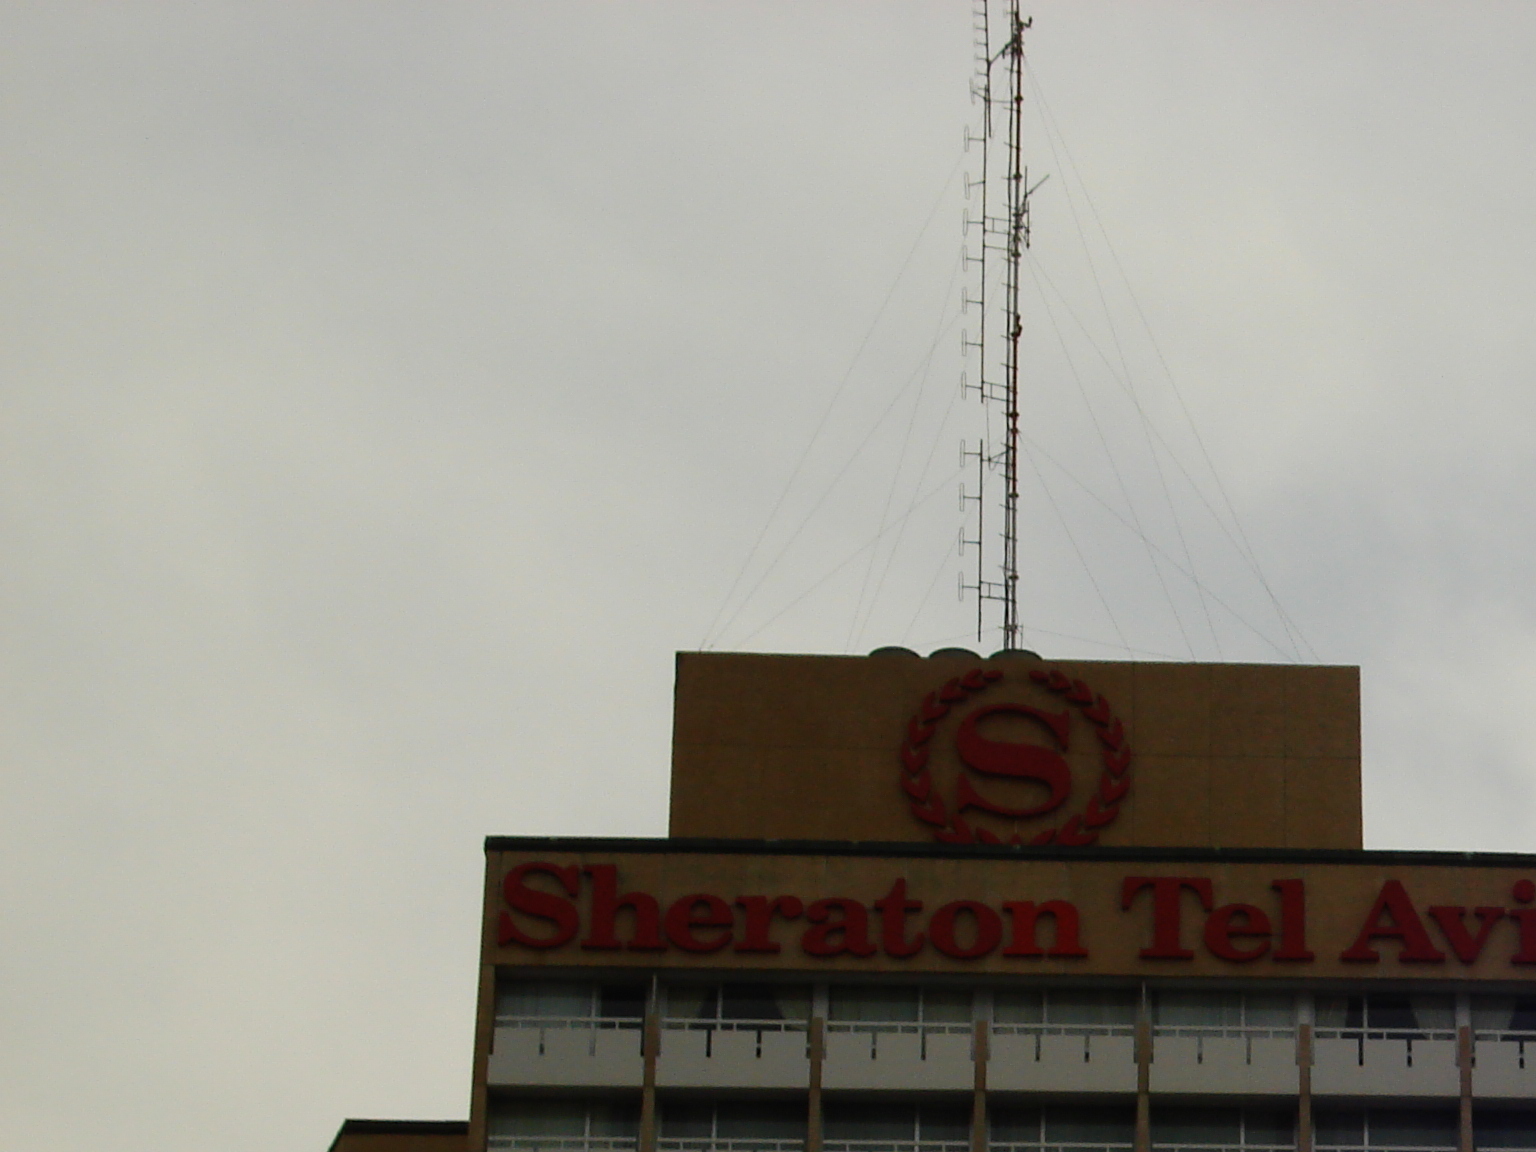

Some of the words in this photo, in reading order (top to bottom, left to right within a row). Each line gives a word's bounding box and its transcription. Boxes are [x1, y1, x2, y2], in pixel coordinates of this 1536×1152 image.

[956, 703, 1071, 819] S
[496, 860, 1088, 958] Sheraton
[1122, 875, 1315, 964] Tel
